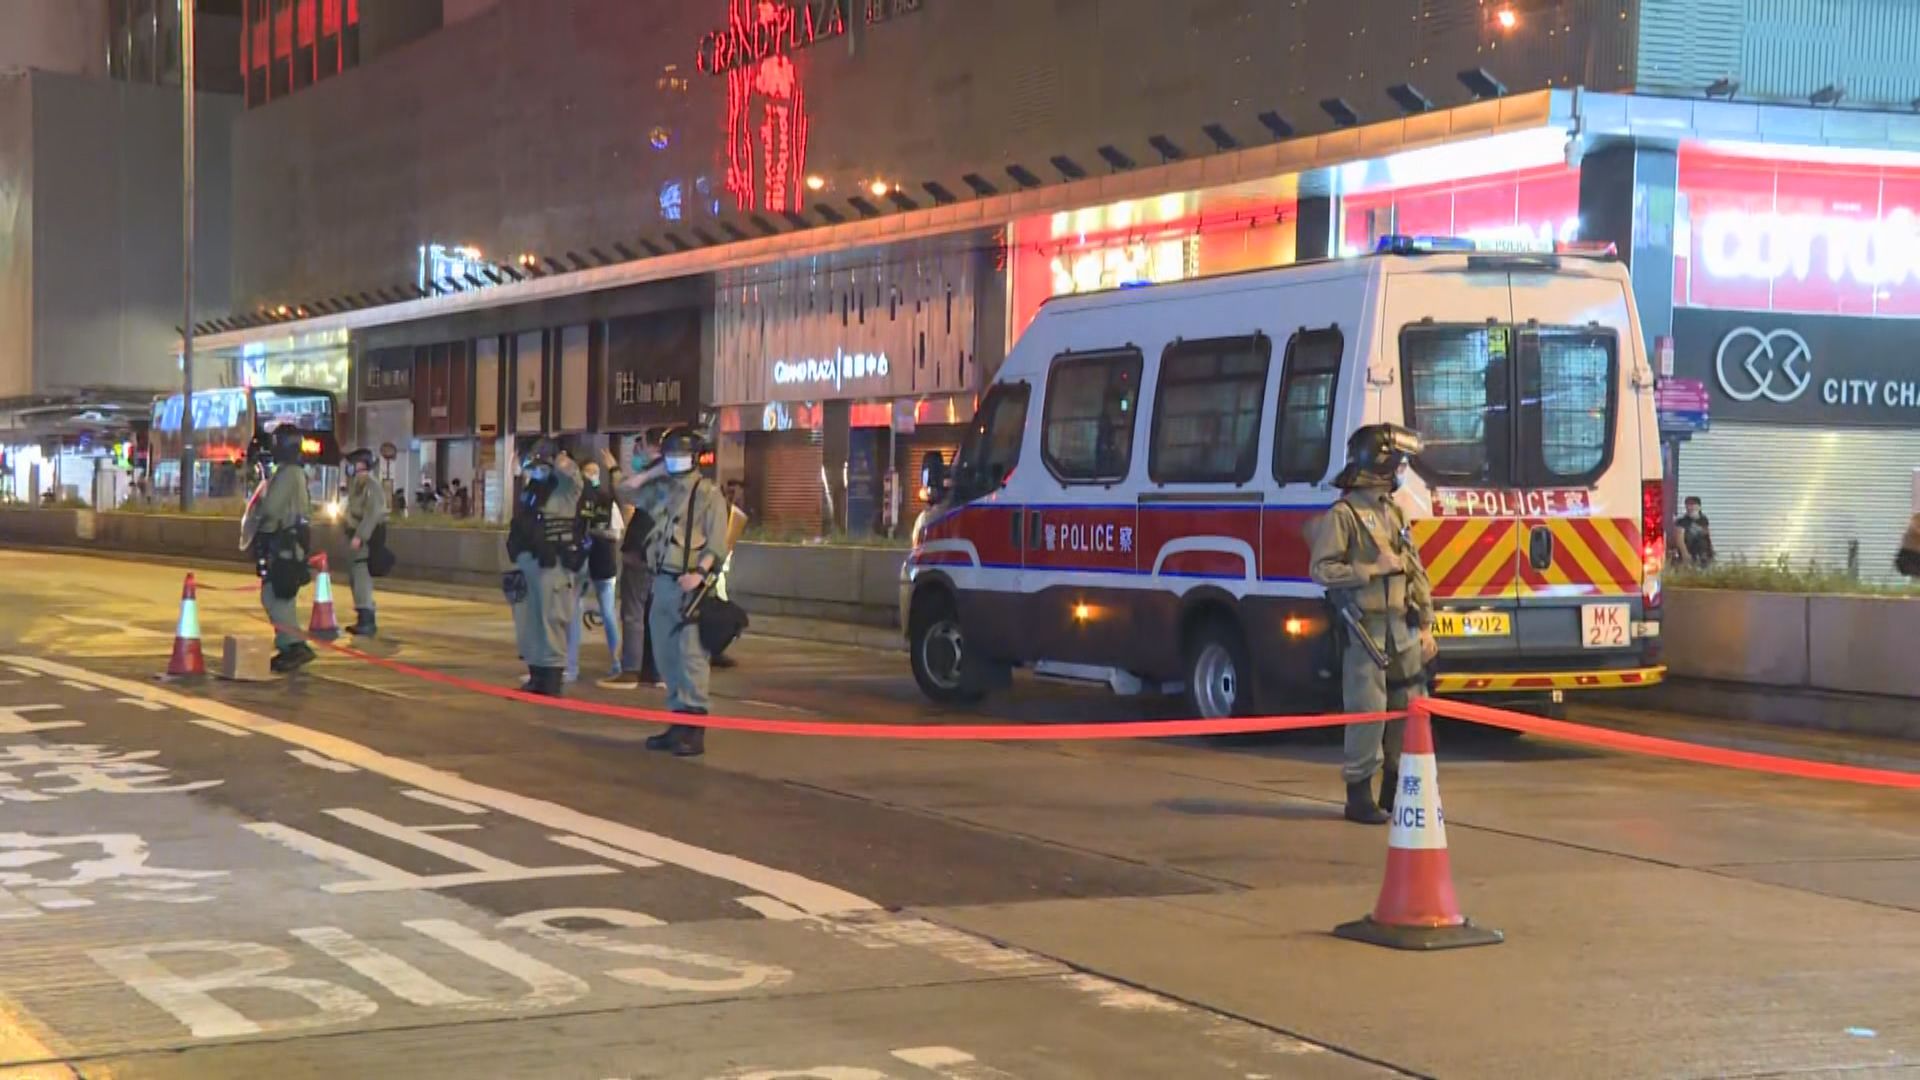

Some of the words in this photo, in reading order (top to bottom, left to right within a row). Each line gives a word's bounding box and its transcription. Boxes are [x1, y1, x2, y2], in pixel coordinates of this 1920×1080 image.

[697, 21, 769, 74] GRAND
[771, 0, 844, 51] PLAZA
[808, 359, 836, 381] PLAZA
[1824, 378, 1877, 405] CITY
[1883, 381, 1920, 408] CH
[1466, 490, 1557, 516] POLICE
[1061, 523, 1114, 552] POLICE
[1431, 616, 1454, 633] AM
[1594, 607, 1618, 625] MK
[1590, 627, 1622, 645] 2/2
[1403, 775, 1421, 795] 察
[86, 907, 794, 1037] BUS
